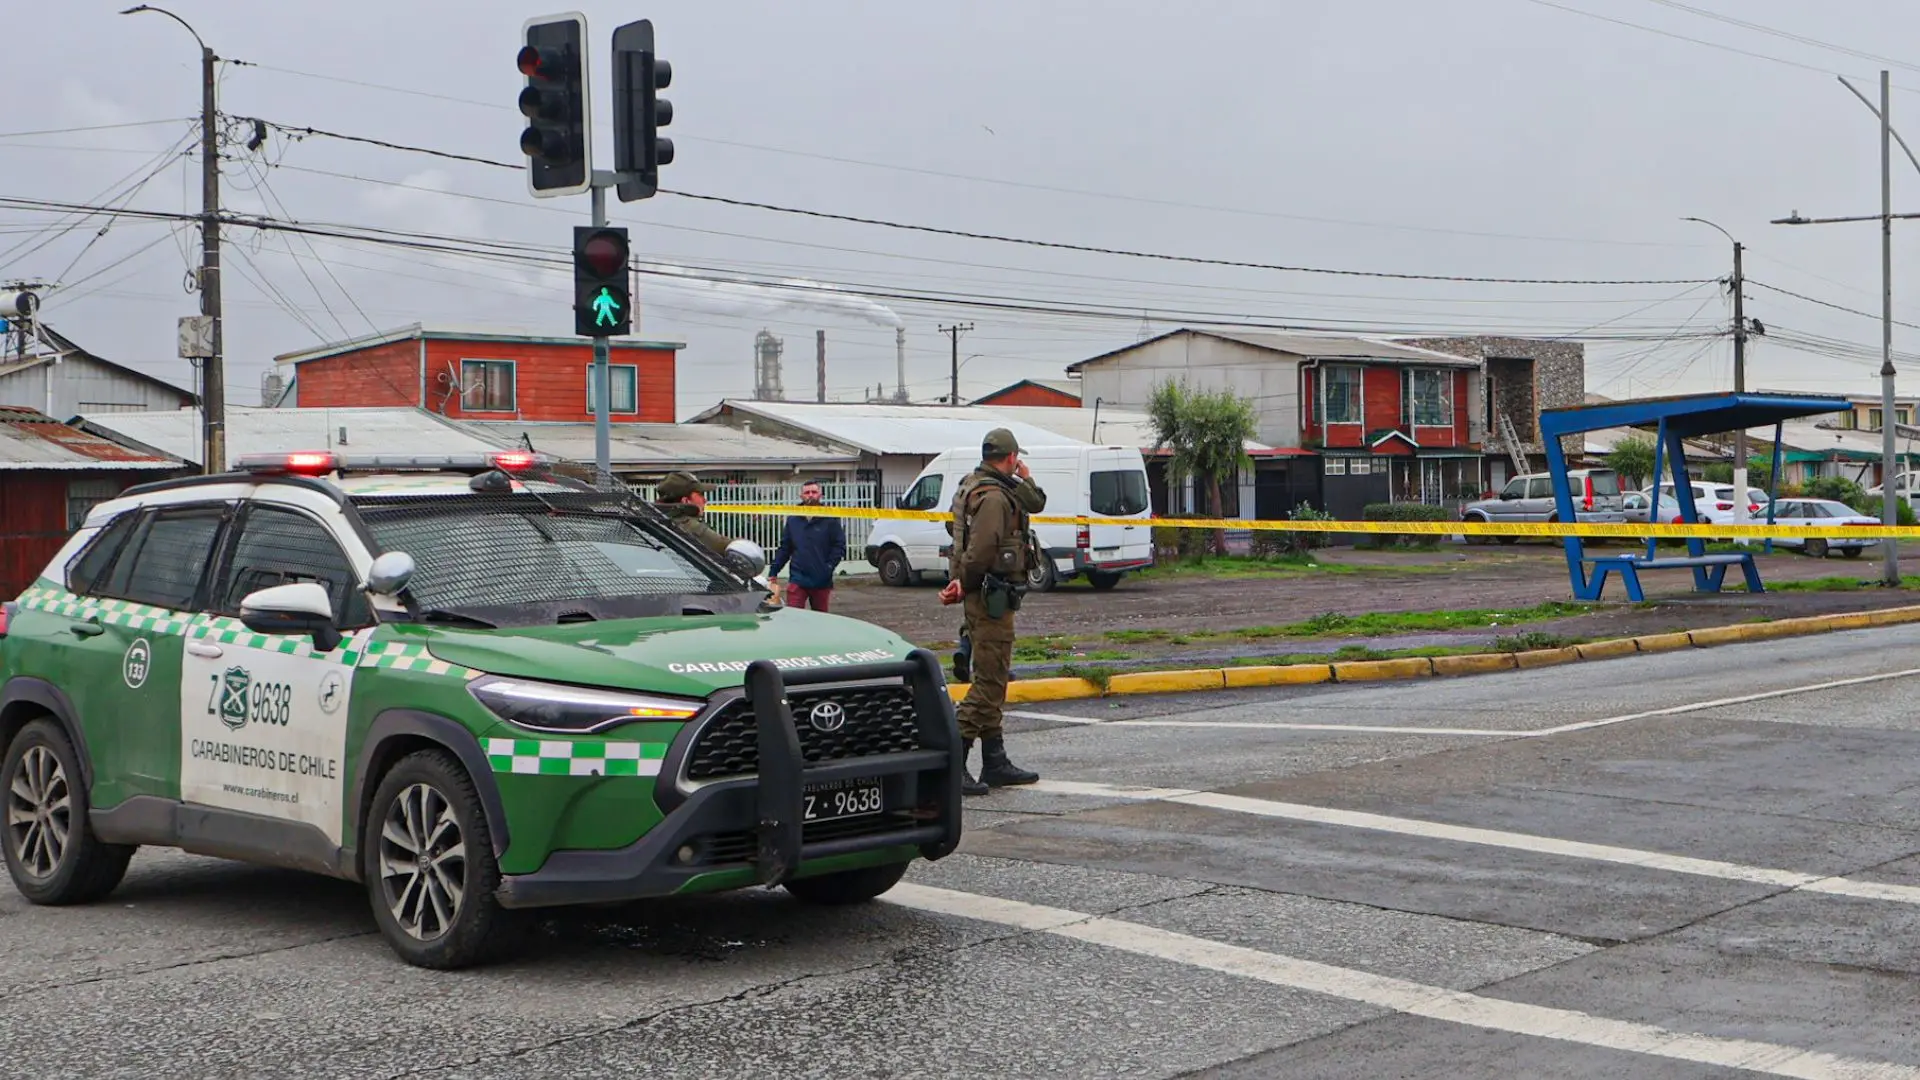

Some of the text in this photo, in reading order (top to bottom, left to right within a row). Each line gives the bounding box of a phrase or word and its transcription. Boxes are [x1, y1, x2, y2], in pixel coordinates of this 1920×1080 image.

[127, 662, 145, 680] 133
[668, 648, 895, 673] CARABEROS DE CHILE
[207, 674, 291, 726] Z 9638
[191, 739, 336, 779] CARABINEROS DE CHILE
[222, 782, 299, 803] www.carabineros.cl
[804, 787, 880, 819] Z 9638
